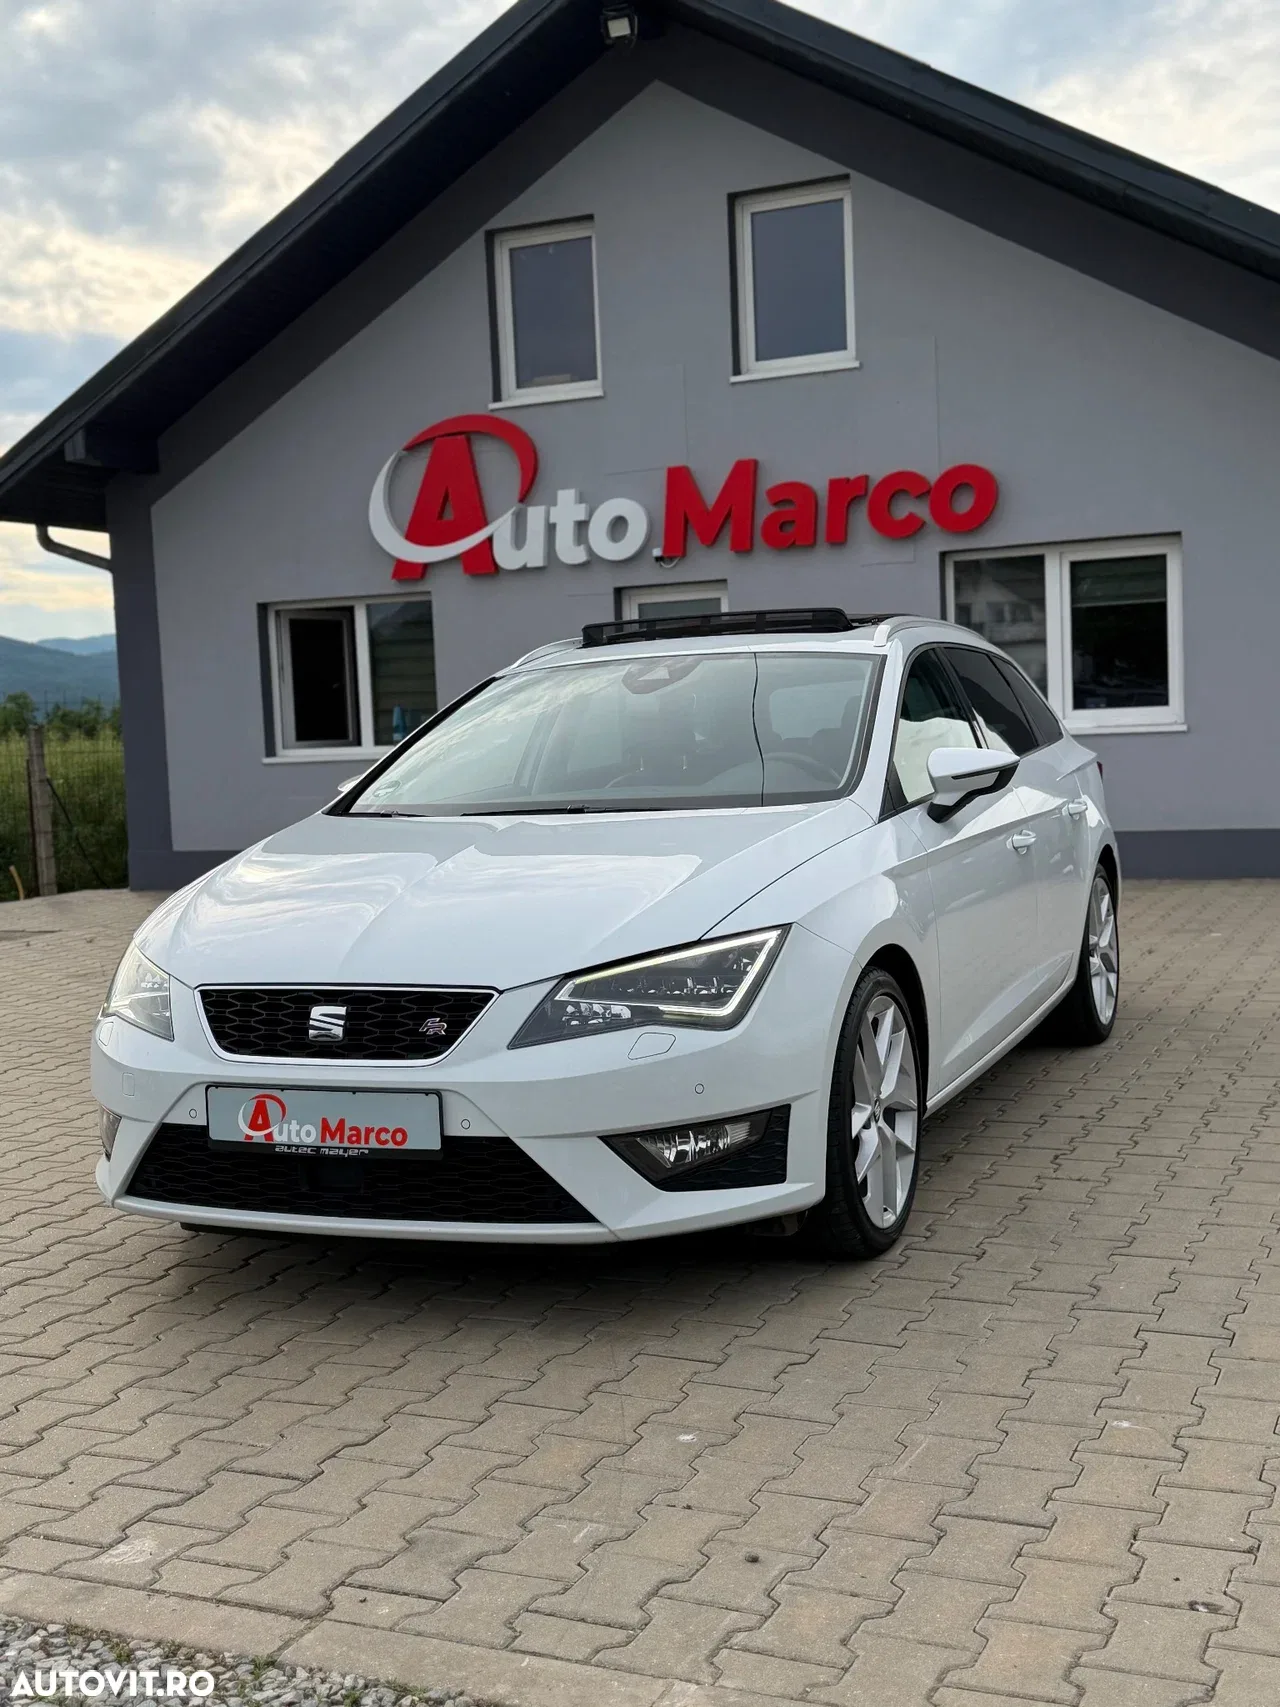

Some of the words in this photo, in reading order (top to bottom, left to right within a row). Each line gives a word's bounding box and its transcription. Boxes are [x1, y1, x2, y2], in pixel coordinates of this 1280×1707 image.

[391, 433, 650, 580] Auto
[661, 458, 999, 557] Marco
[243, 1098, 317, 1143] Auto
[319, 1117, 408, 1147] Marco
[319, 1147, 369, 1158] mayer
